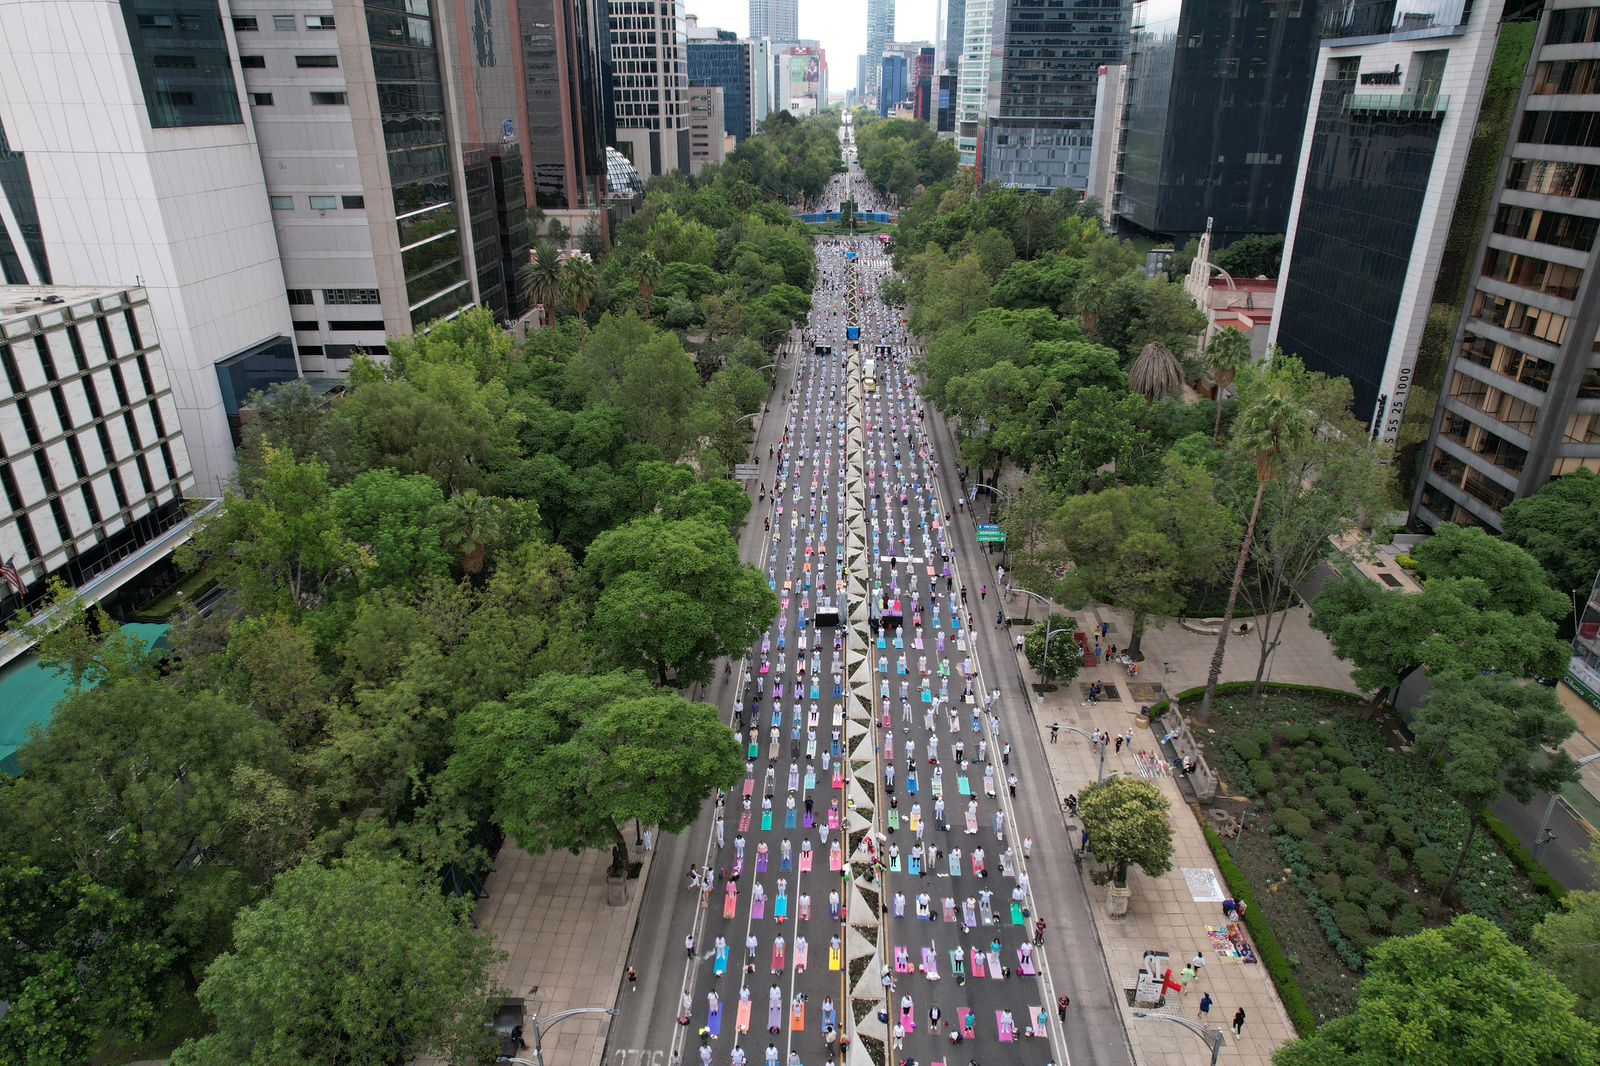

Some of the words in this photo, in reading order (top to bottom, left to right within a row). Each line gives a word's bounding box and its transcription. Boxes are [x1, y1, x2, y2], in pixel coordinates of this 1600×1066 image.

[1360, 63, 1402, 85] wework
[1396, 368, 1411, 395] 1000
[1391, 401, 1403, 414] 25
[1387, 419, 1399, 433] 55
